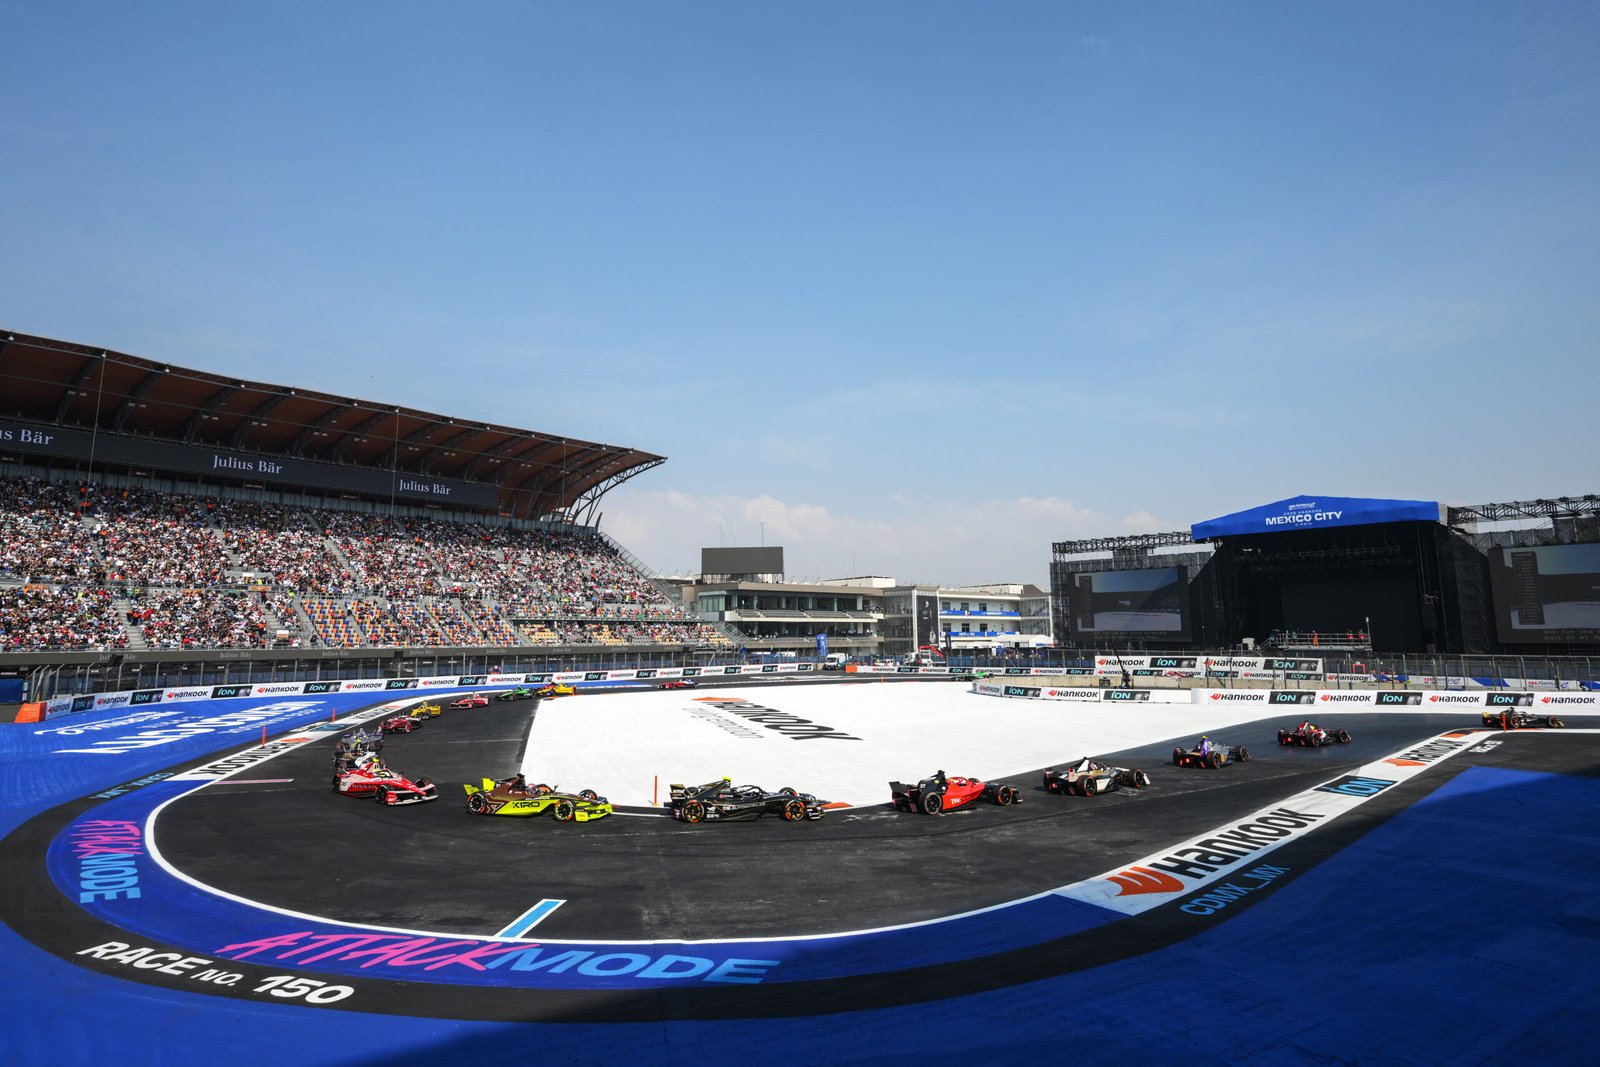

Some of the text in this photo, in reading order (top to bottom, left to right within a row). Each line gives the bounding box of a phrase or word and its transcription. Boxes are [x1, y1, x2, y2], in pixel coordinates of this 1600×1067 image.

[19, 429, 54, 445] Bär
[213, 454, 283, 475] Julius Bär
[399, 480, 452, 496] Julius Bär
[1266, 511, 1342, 526] MEXICO CITY
[1057, 690, 1098, 698] Hankook
[1220, 693, 1264, 701] Hankook
[1151, 808, 1326, 880] Hankook
[70, 819, 144, 904] ATTACK MODE
[1180, 864, 1292, 916] CDMX_MX
[214, 931, 782, 984] ATTACK MODE
[76, 941, 355, 1004] RACE NO. 150
